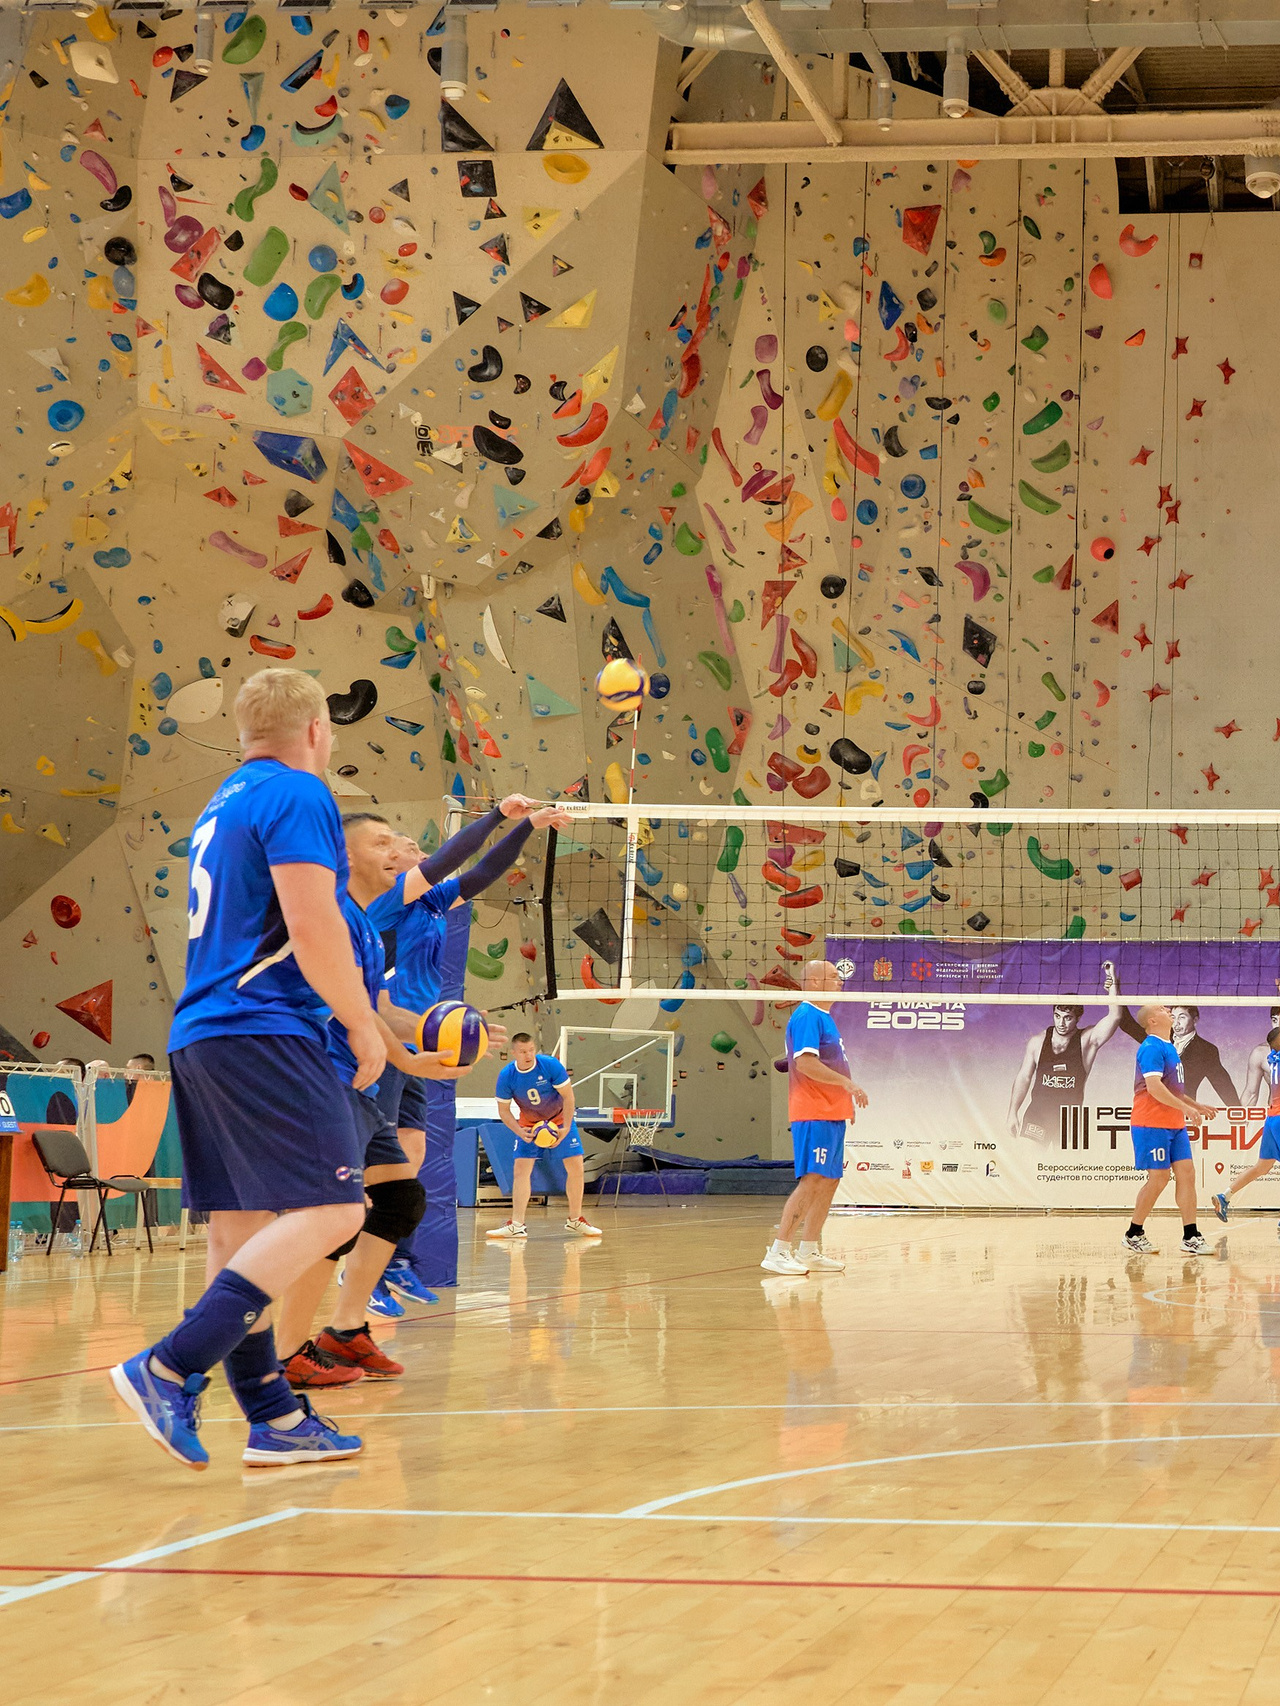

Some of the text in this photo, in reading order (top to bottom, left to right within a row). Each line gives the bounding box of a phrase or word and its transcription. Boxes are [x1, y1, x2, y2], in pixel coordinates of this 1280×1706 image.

[188, 816, 217, 940] 3
[867, 1011, 964, 1031] 2025
[527, 1088, 541, 1106] 9
[813, 1147, 827, 1165] 15
[1150, 1147, 1165, 1162] 10
[1037, 1163, 1104, 1172] Всероссийские
[1037, 1173, 1079, 1183] студентов
[1094, 1172, 1145, 1183] спортивной
